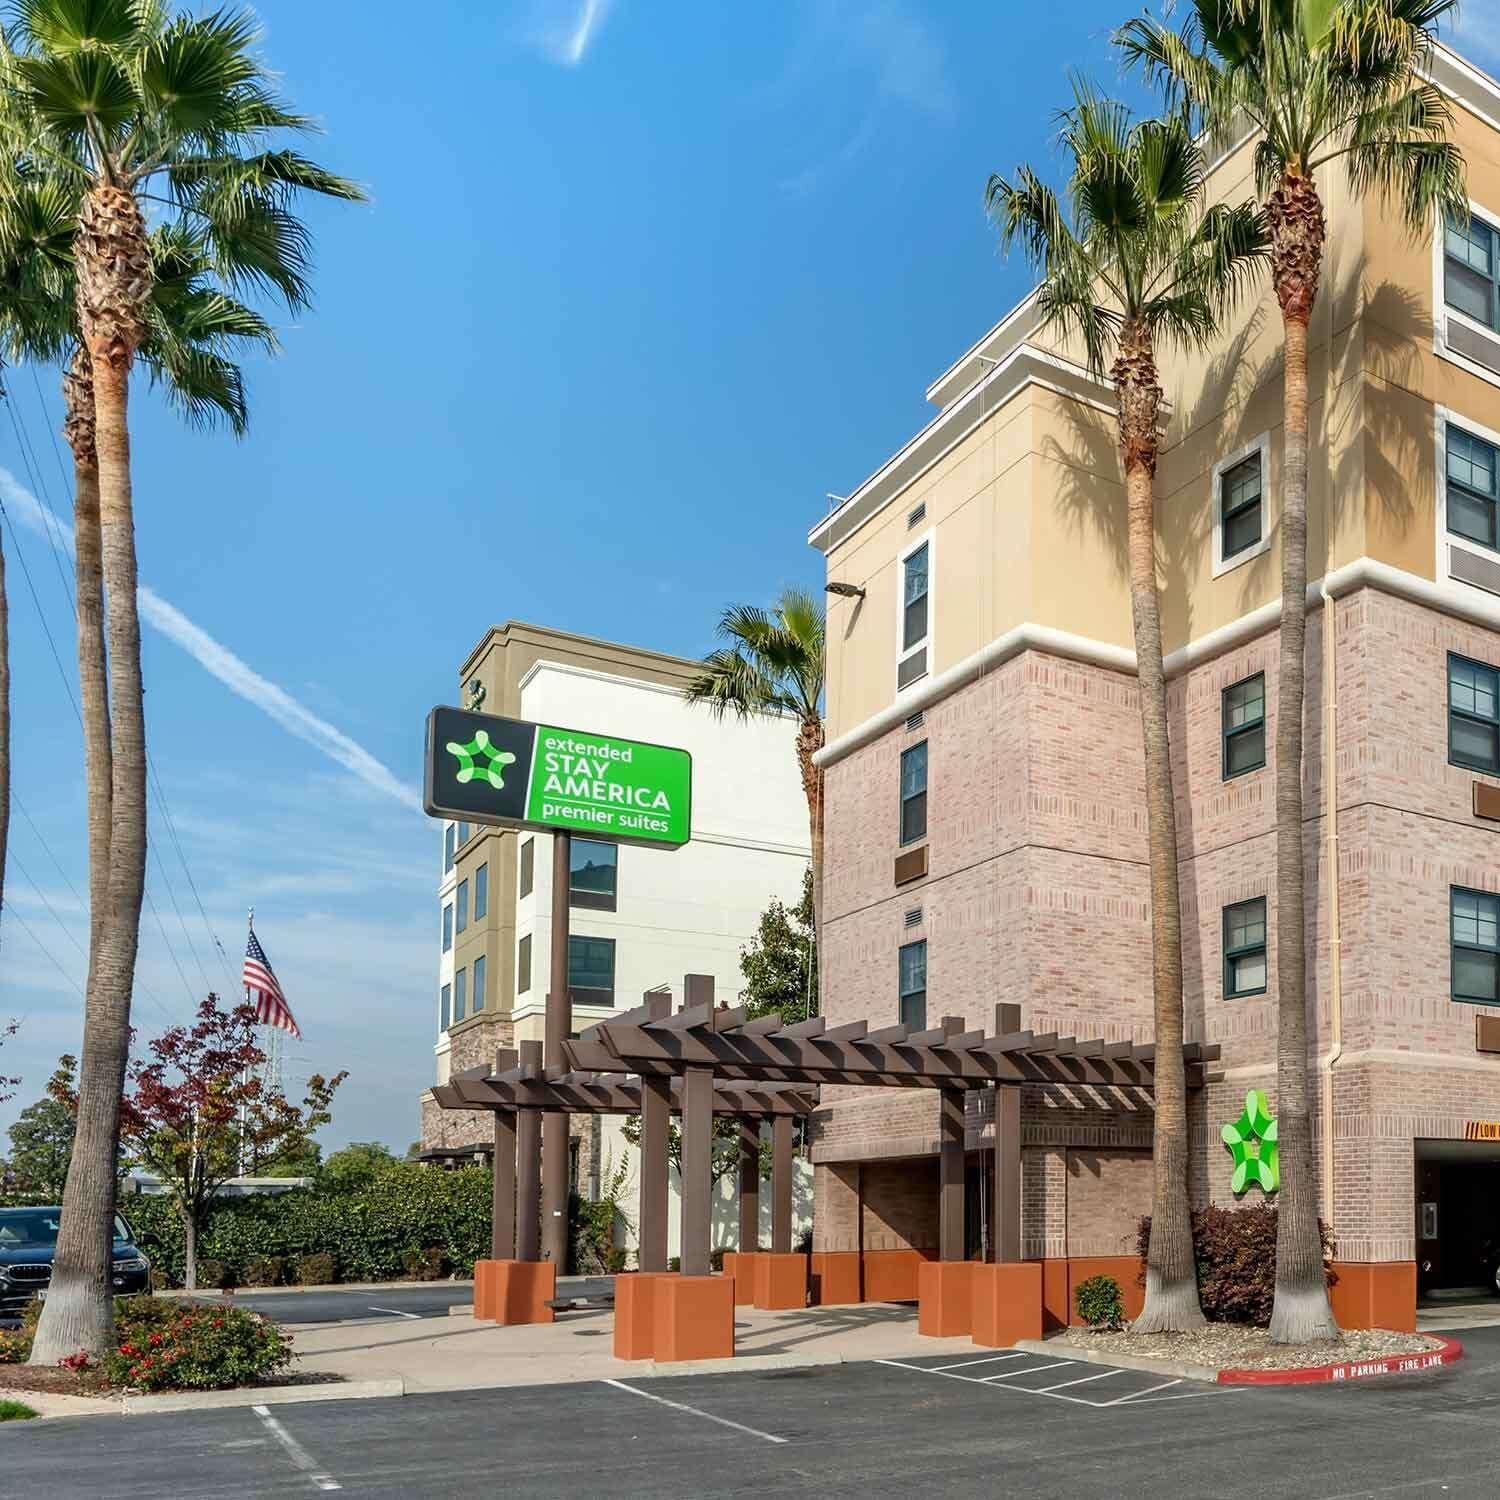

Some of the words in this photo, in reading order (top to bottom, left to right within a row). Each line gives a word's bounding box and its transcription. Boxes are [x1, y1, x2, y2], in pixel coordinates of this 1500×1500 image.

[545, 737, 632, 763] extended
[545, 752, 609, 780] STAY
[544, 775, 671, 811] AMERICA
[542, 803, 614, 825] premier
[619, 811, 669, 833] suites
[1480, 1124, 1497, 1138] LOW
[1333, 1368, 1344, 1378] NO
[1351, 1363, 1389, 1377] PARKING
[1399, 1359, 1419, 1372] FIRE
[1423, 1355, 1442, 1368] LANE
